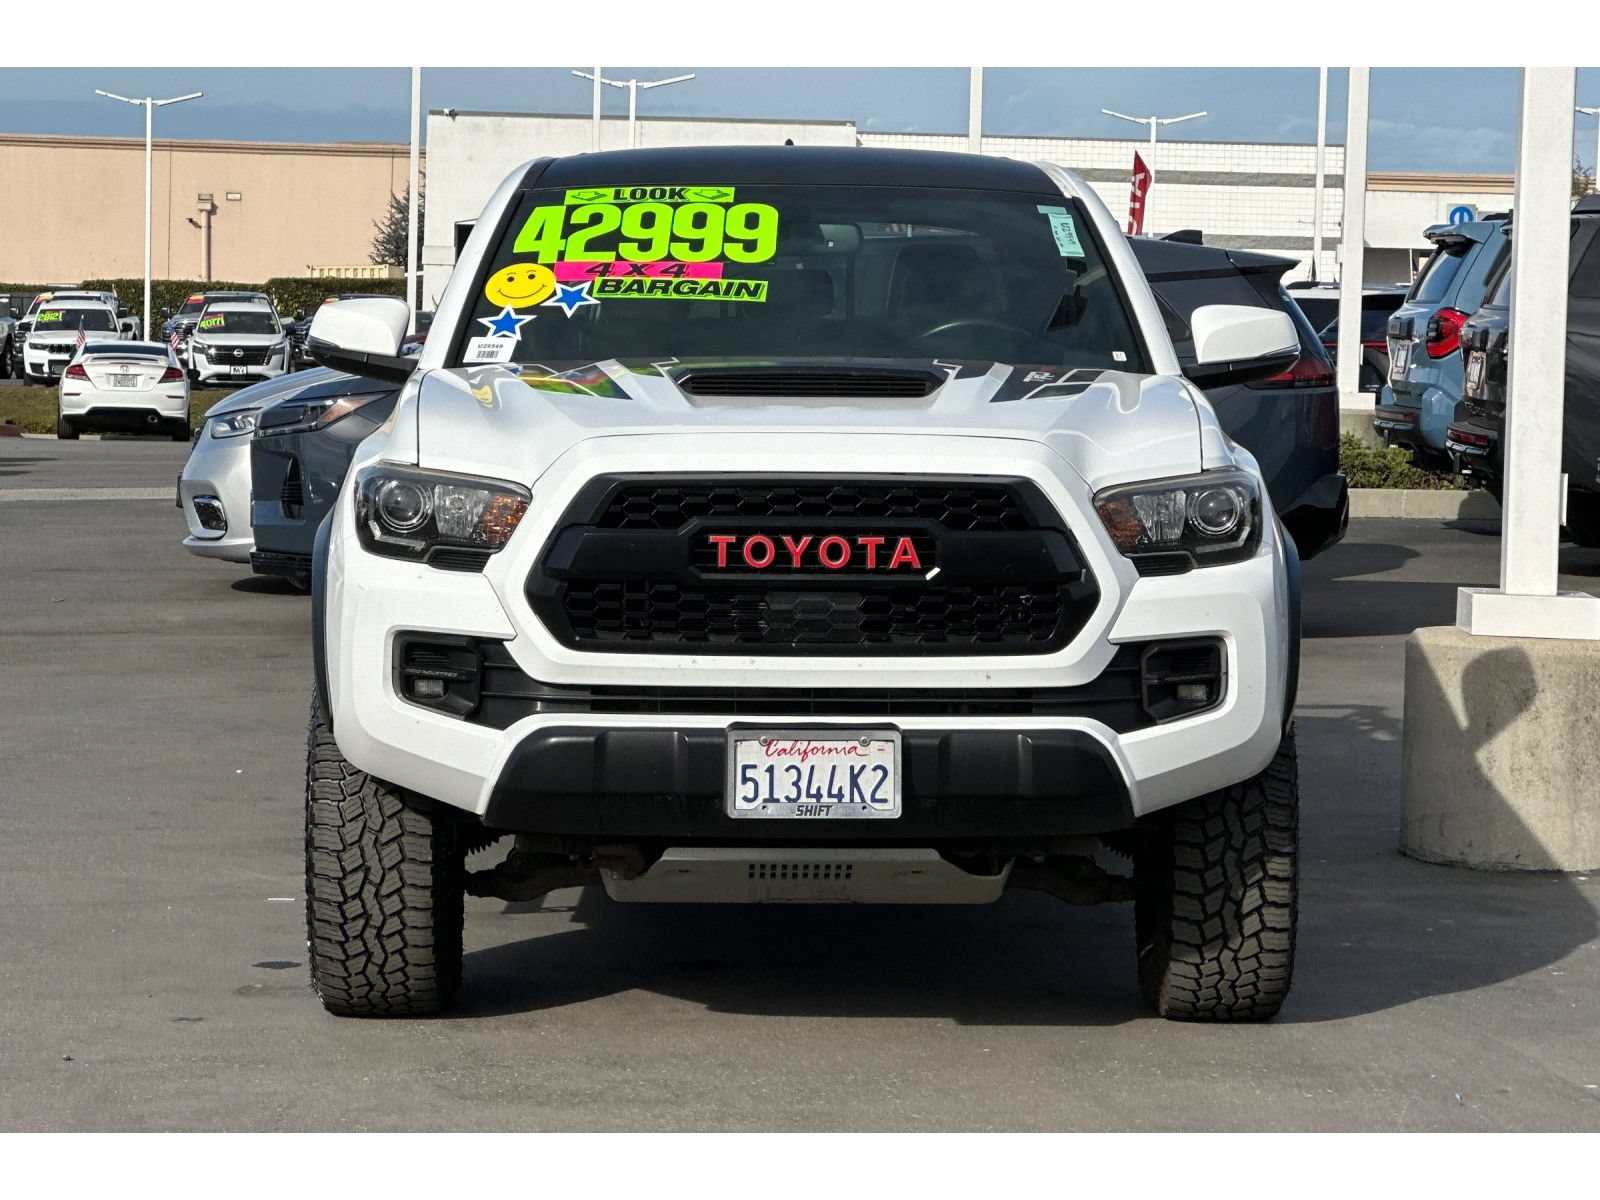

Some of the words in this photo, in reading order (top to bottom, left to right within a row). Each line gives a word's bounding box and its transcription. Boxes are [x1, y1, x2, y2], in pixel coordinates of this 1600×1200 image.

[612, 187, 688, 201] LOOK
[513, 203, 779, 263] 42999
[596, 278, 765, 298] BARGAIN
[709, 535, 922, 569] TOYOTA
[764, 740, 869, 763] California
[740, 763, 889, 804] 51344K2
[796, 804, 833, 817] SHIFT
